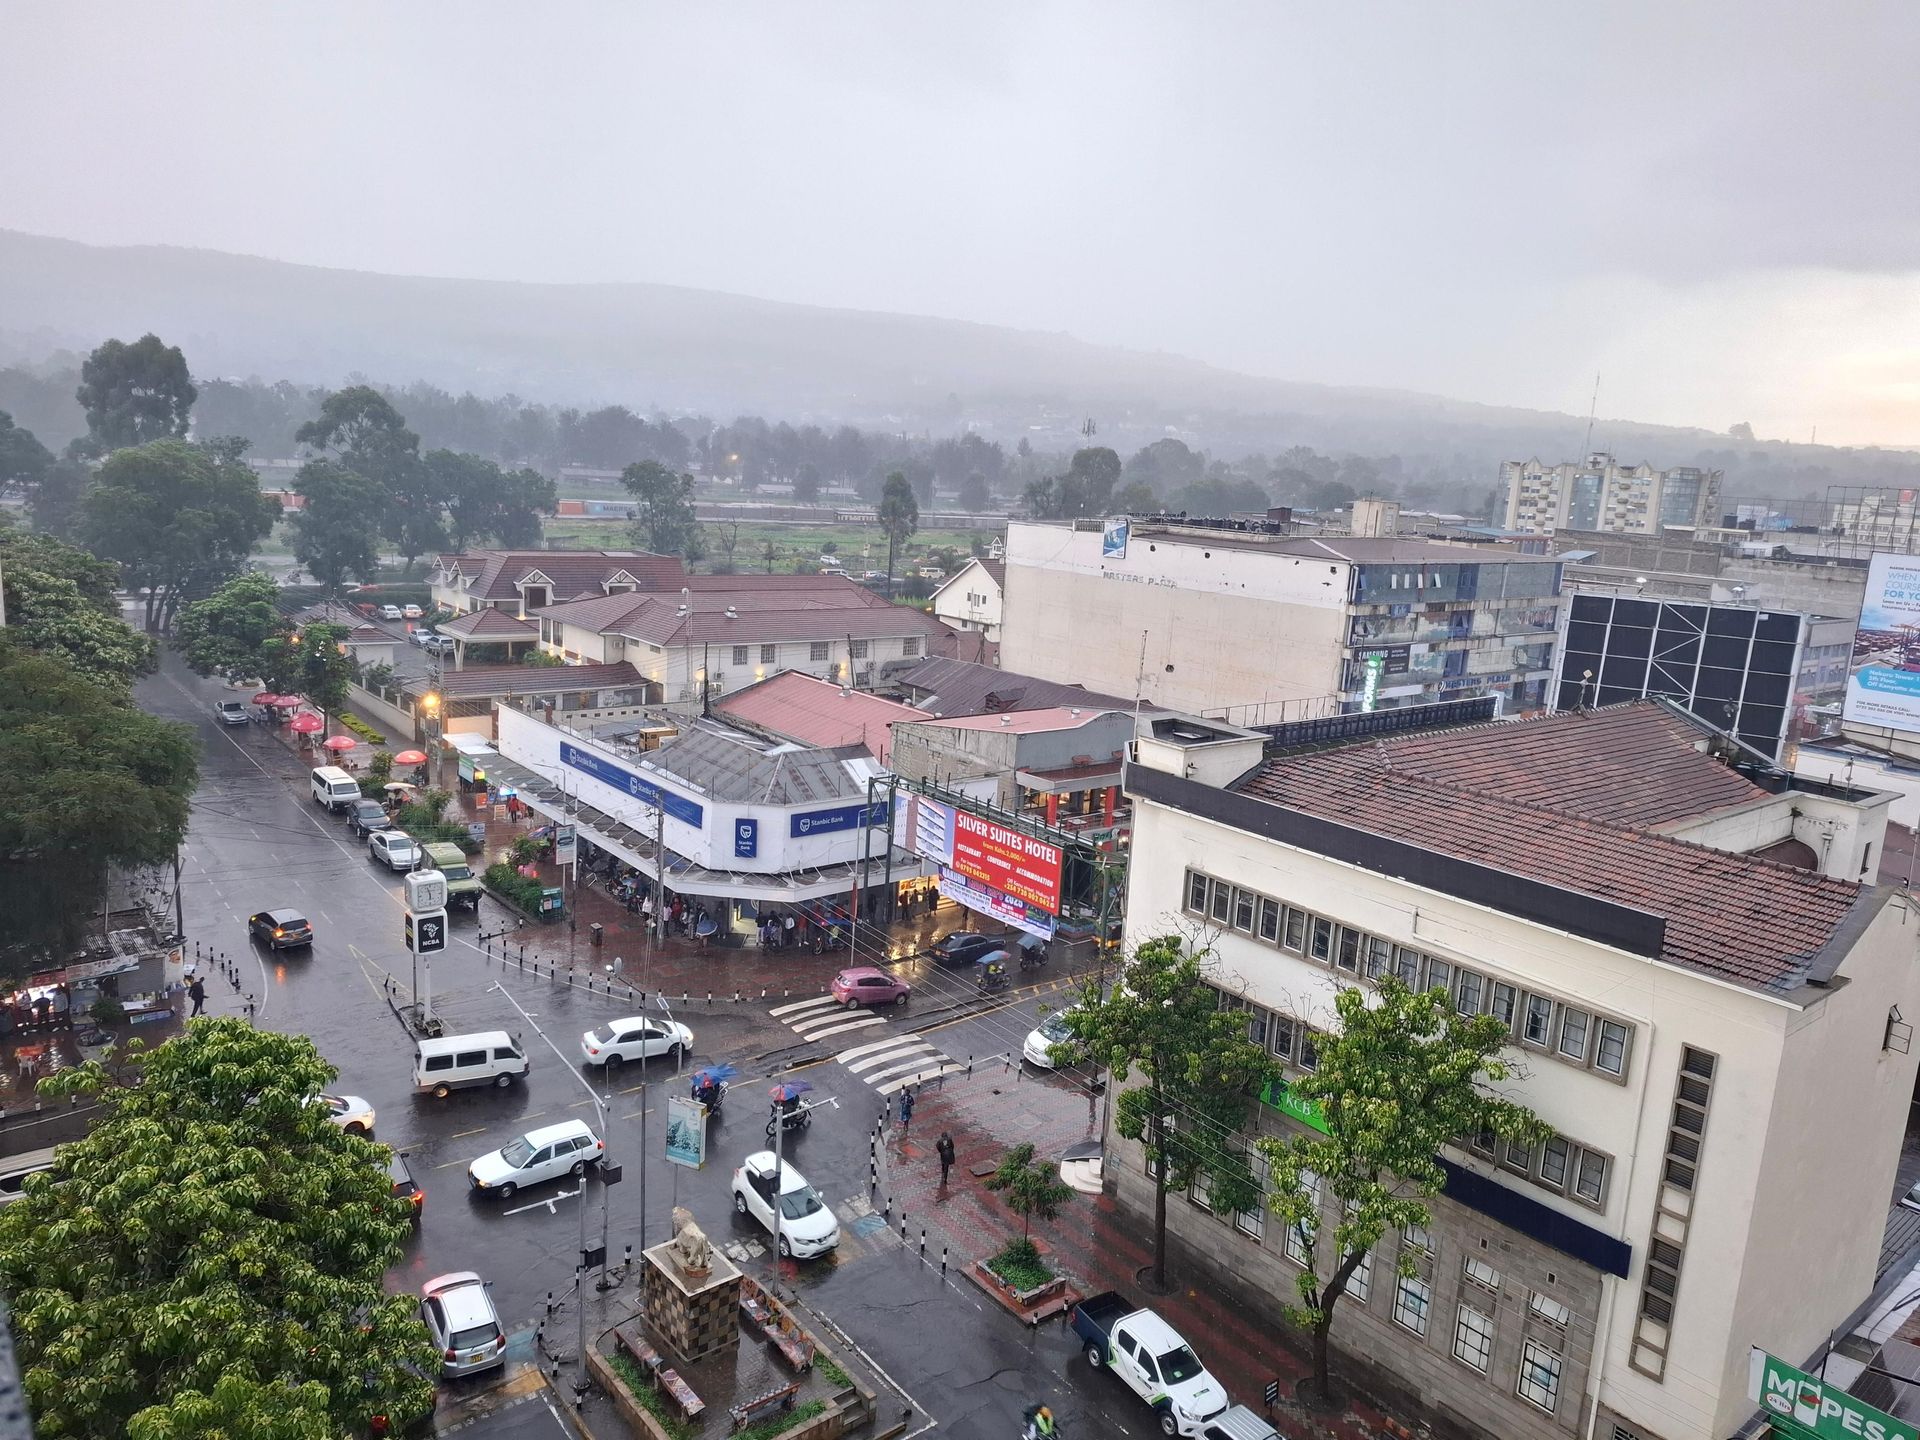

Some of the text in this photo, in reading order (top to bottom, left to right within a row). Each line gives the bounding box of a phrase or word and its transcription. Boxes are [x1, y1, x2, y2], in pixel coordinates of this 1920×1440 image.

[1884, 590, 1905, 599] FOR
[638, 784, 652, 797] Stanbic
[811, 819, 830, 827] Stanbic
[958, 814, 1058, 865] SILVER SUITES HOTEL
[987, 855, 1012, 871] CONFERENCE
[1016, 867, 1054, 888] ACCOMMODATION
[423, 939, 440, 947] NCBA
[1287, 1093, 1311, 1116] KCB
